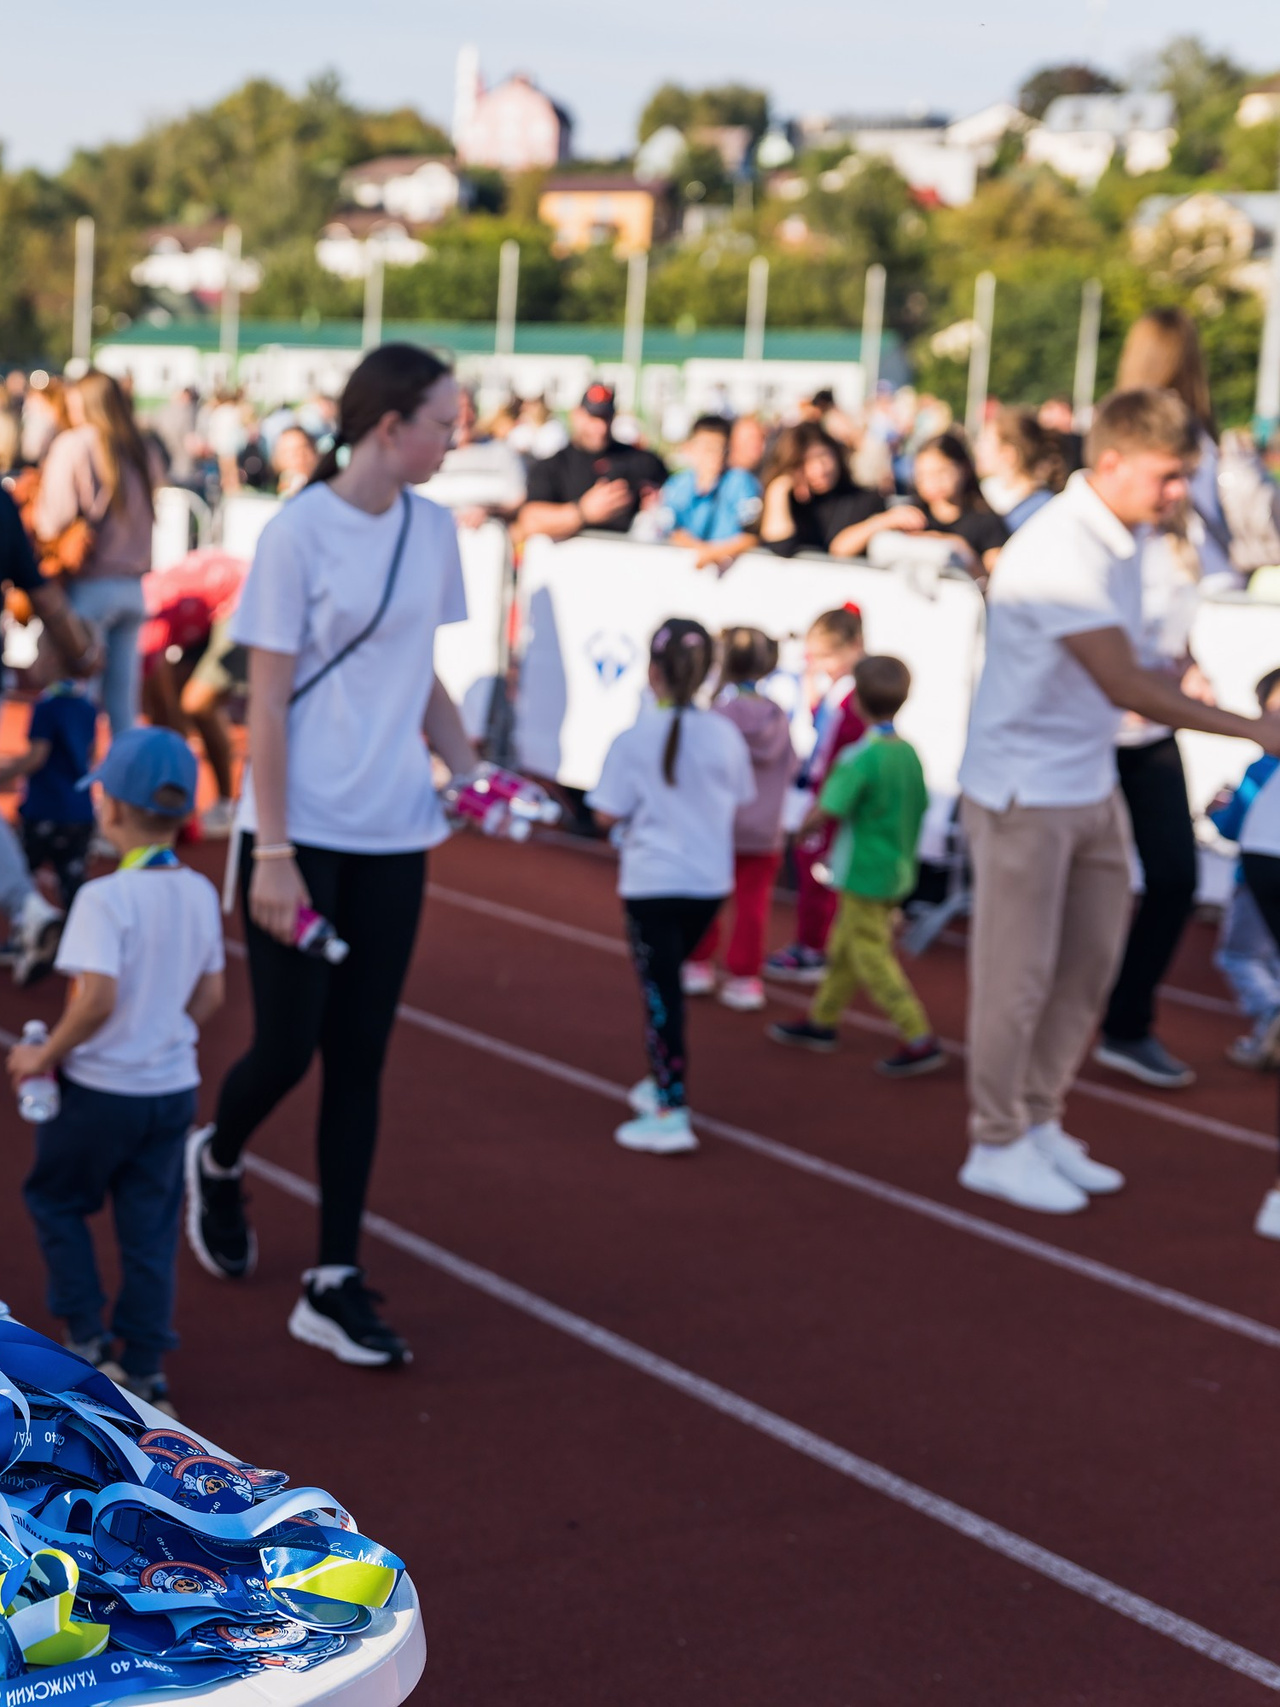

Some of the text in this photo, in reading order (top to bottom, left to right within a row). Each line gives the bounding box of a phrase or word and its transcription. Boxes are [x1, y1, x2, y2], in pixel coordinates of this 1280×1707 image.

[214, 1501, 221, 1509] 40
[77, 1550, 93, 1561] 40
[110, 1660, 131, 1675] 40
[134, 1658, 173, 1673] СПОРТ
[6, 1669, 97, 1706] КАЛУЖСКИЙ
